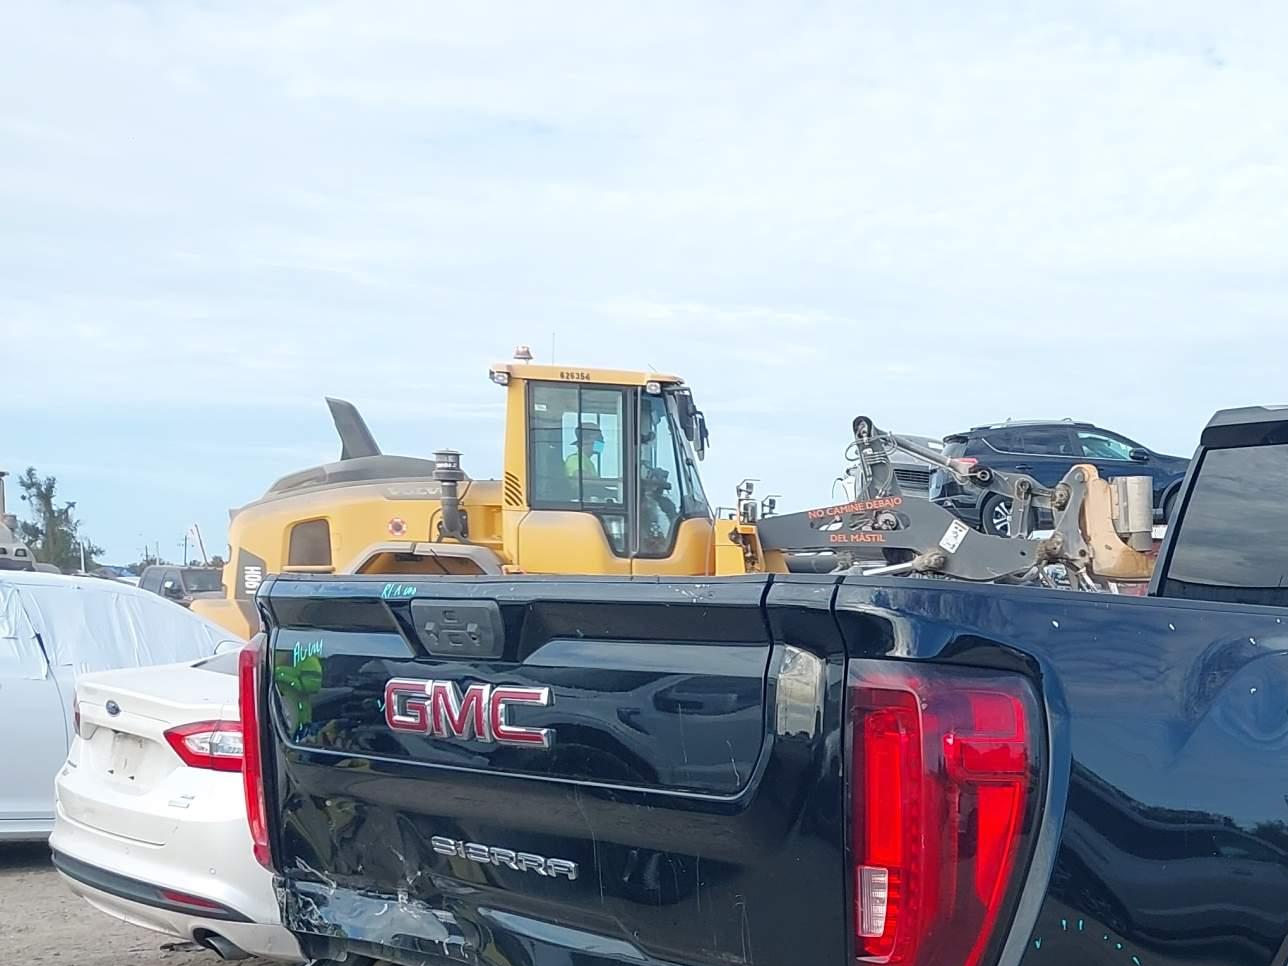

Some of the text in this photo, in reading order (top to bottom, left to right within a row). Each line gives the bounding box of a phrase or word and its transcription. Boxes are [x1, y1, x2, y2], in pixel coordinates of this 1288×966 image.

[808, 497, 902, 519] NO CAMINE DEBAJO
[830, 532, 885, 542] DEL MÁSTIL
[384, 677, 556, 749] GMC
[431, 835, 579, 881] SIERRA
